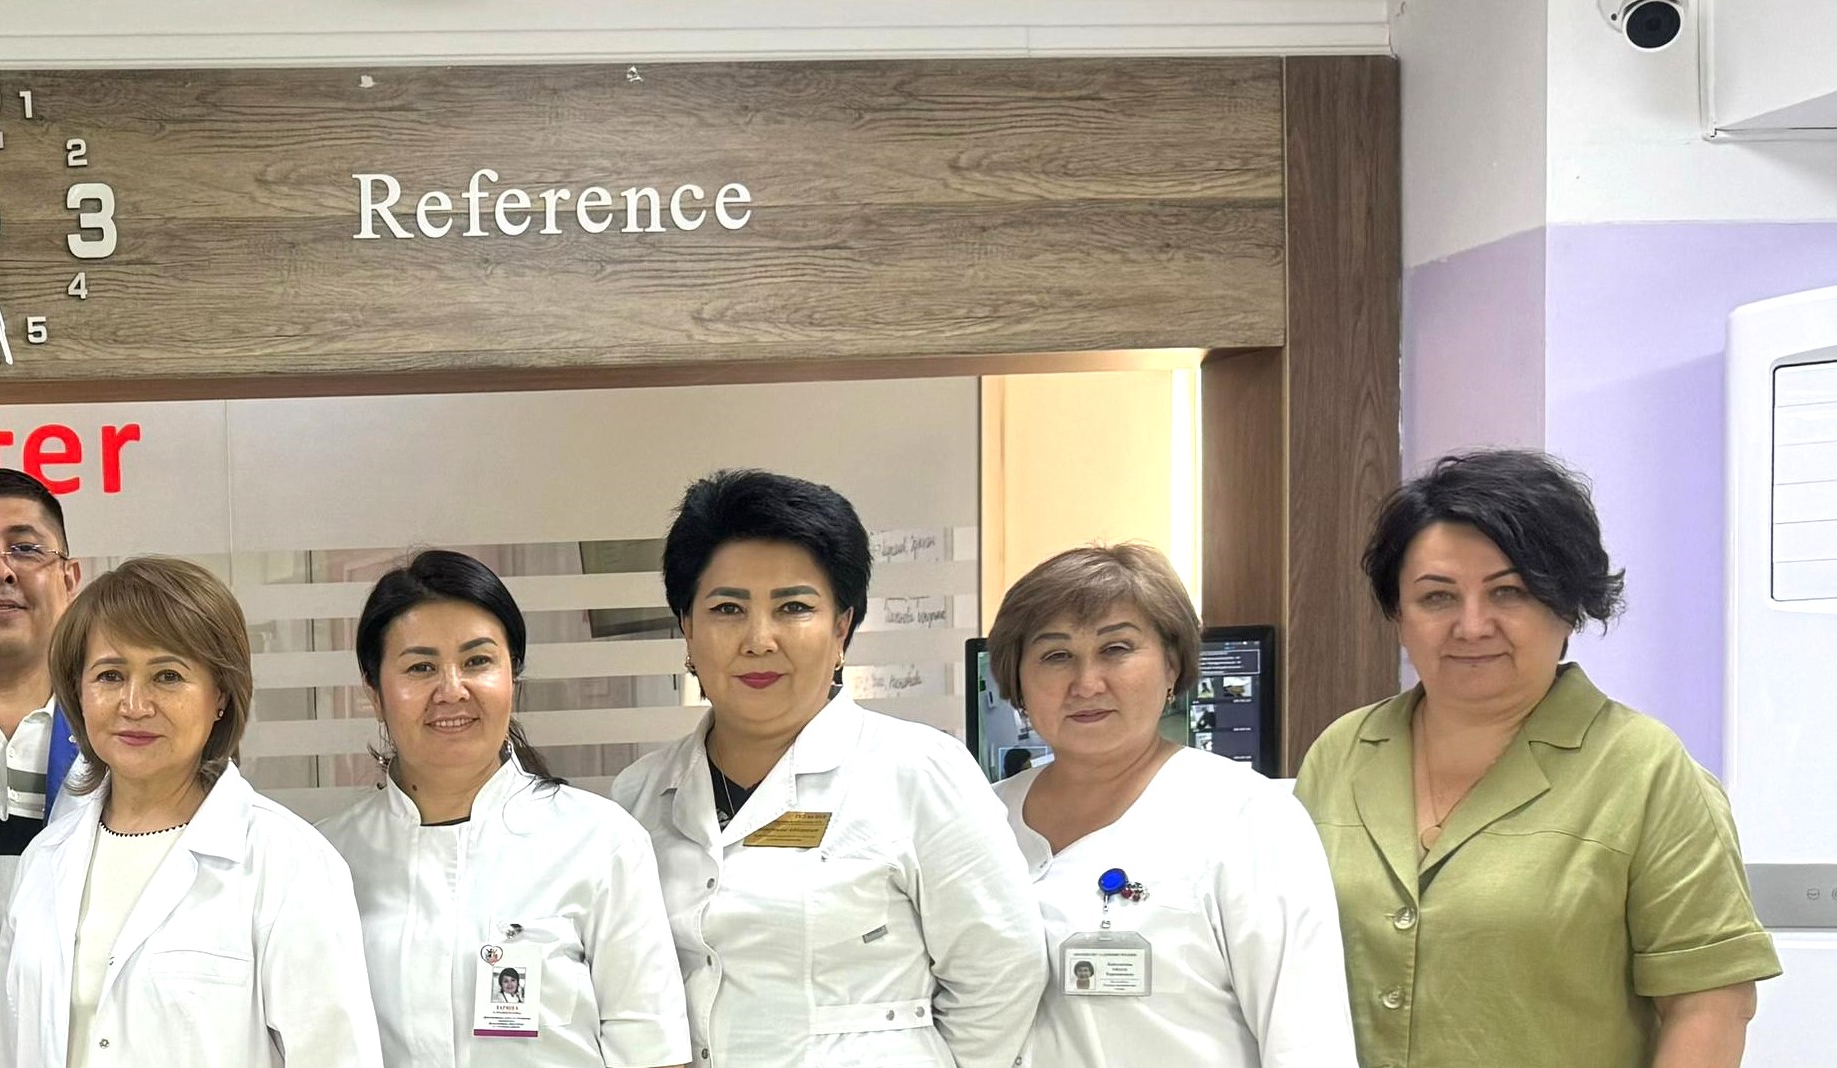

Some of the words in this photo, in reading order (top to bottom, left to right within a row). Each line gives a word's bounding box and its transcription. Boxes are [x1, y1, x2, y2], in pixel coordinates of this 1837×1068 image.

[19, 90, 33, 119] 1
[66, 138, 88, 166] 2
[352, 167, 754, 241] Reference
[66, 182, 117, 259] 3
[67, 271, 88, 300] 4
[26, 316, 47, 344] 5
